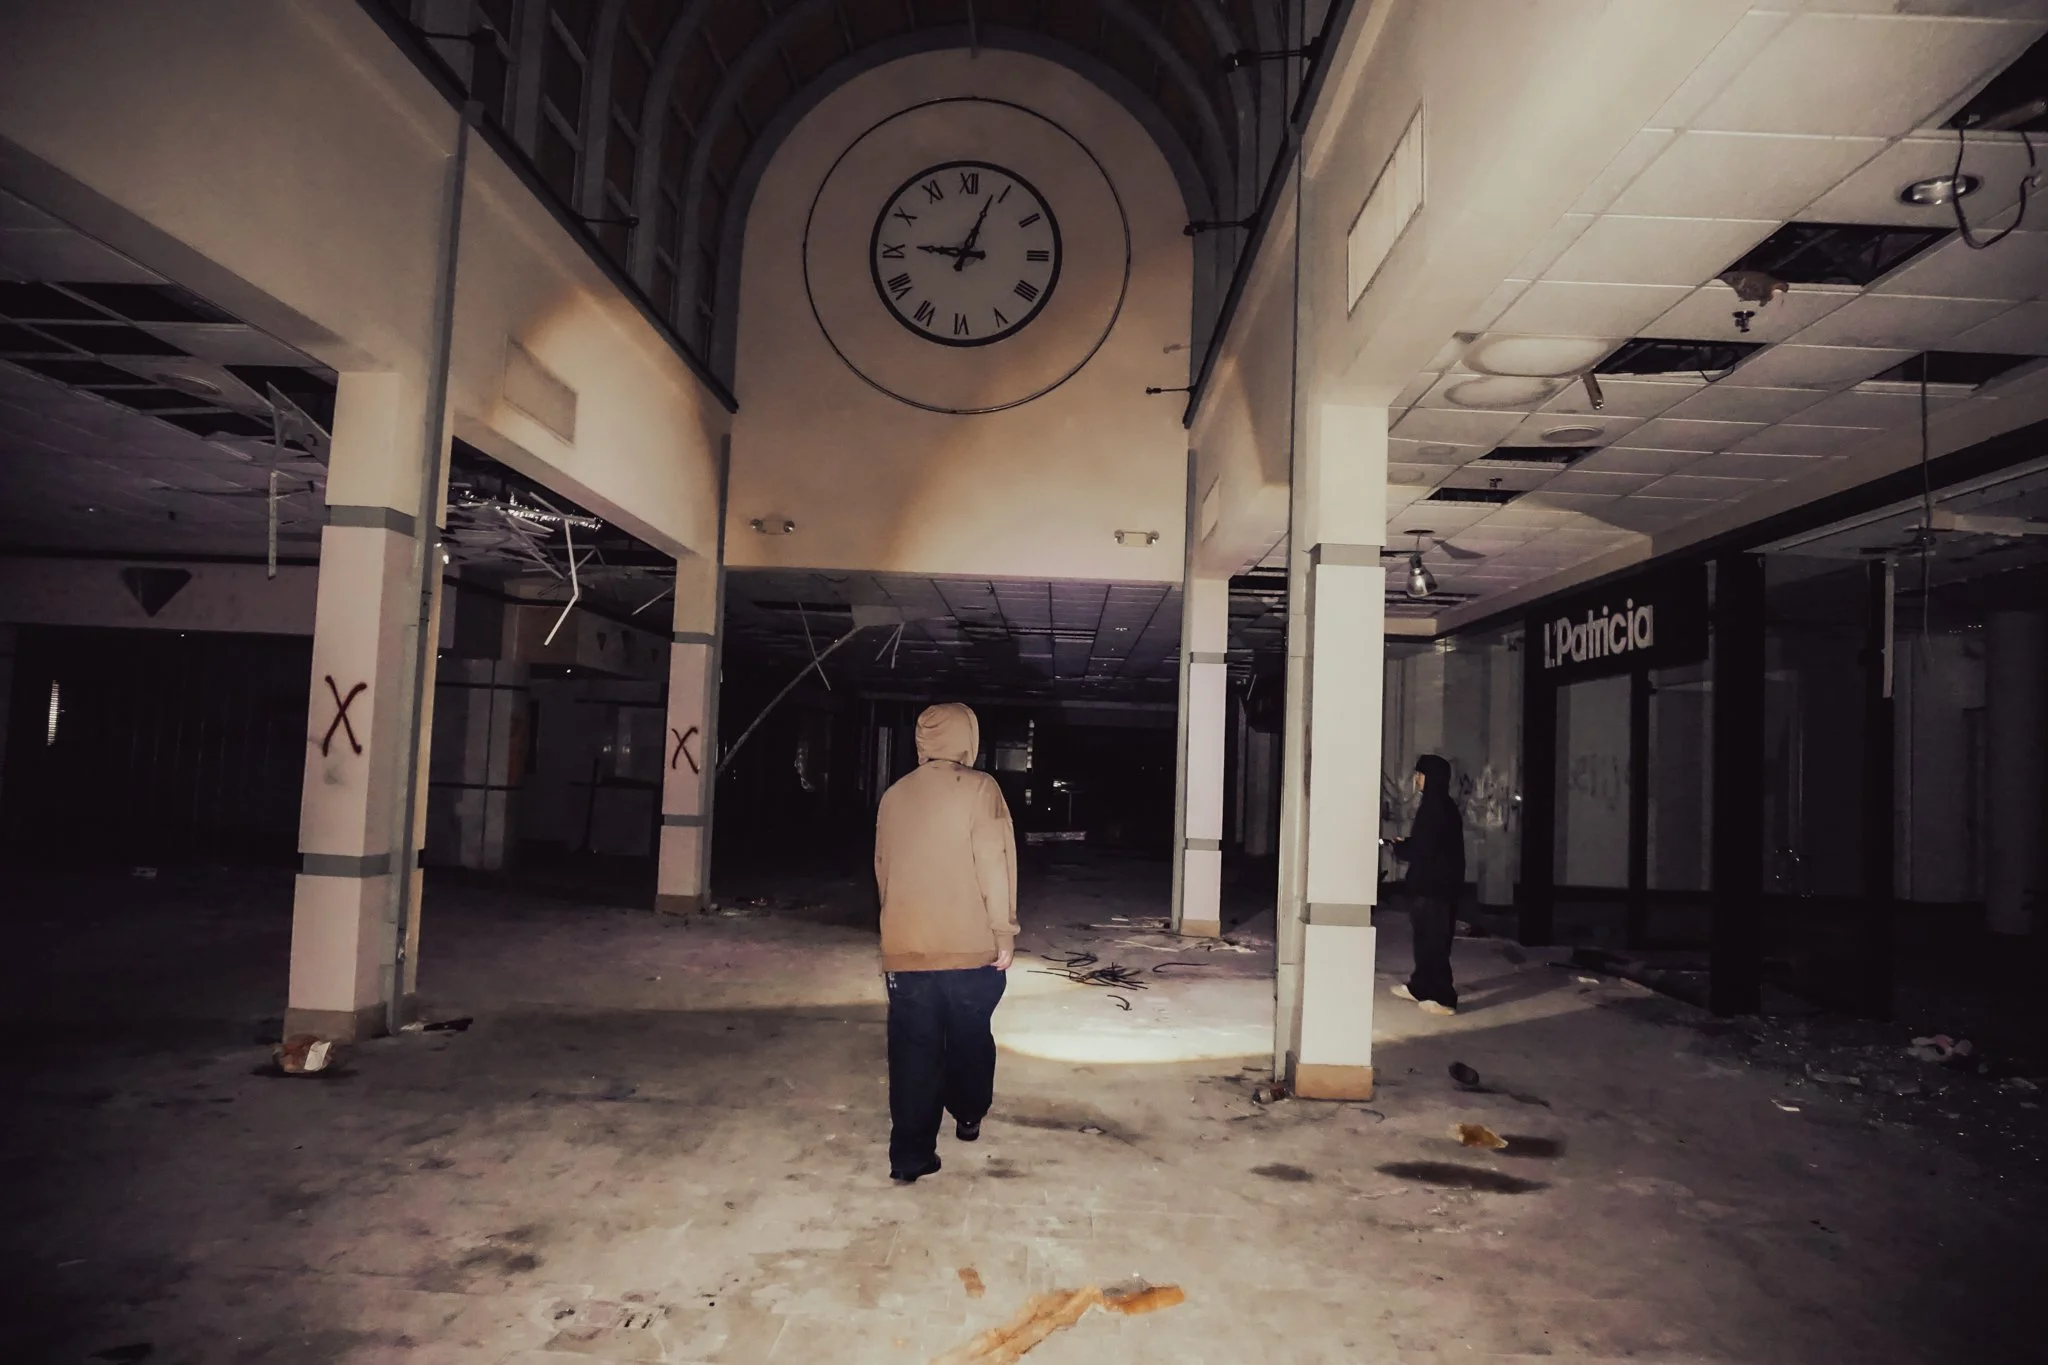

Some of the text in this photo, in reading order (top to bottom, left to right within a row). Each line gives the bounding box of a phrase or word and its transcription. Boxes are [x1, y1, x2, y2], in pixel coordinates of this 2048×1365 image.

[921, 179, 944, 204] XI
[960, 172, 979, 195] XII
[998, 184, 1012, 204] I
[893, 206, 918, 227] X
[1018, 212, 1041, 229] II
[882, 243, 906, 259] IX
[1026, 250, 1050, 262] III
[887, 272, 913, 301] VIII
[1013, 279, 1040, 303] IIII
[913, 299, 936, 328] VII
[954, 312, 969, 336] VI
[993, 306, 1009, 328] V
[322, 675, 367, 757] X
[672, 727, 699, 774] X
